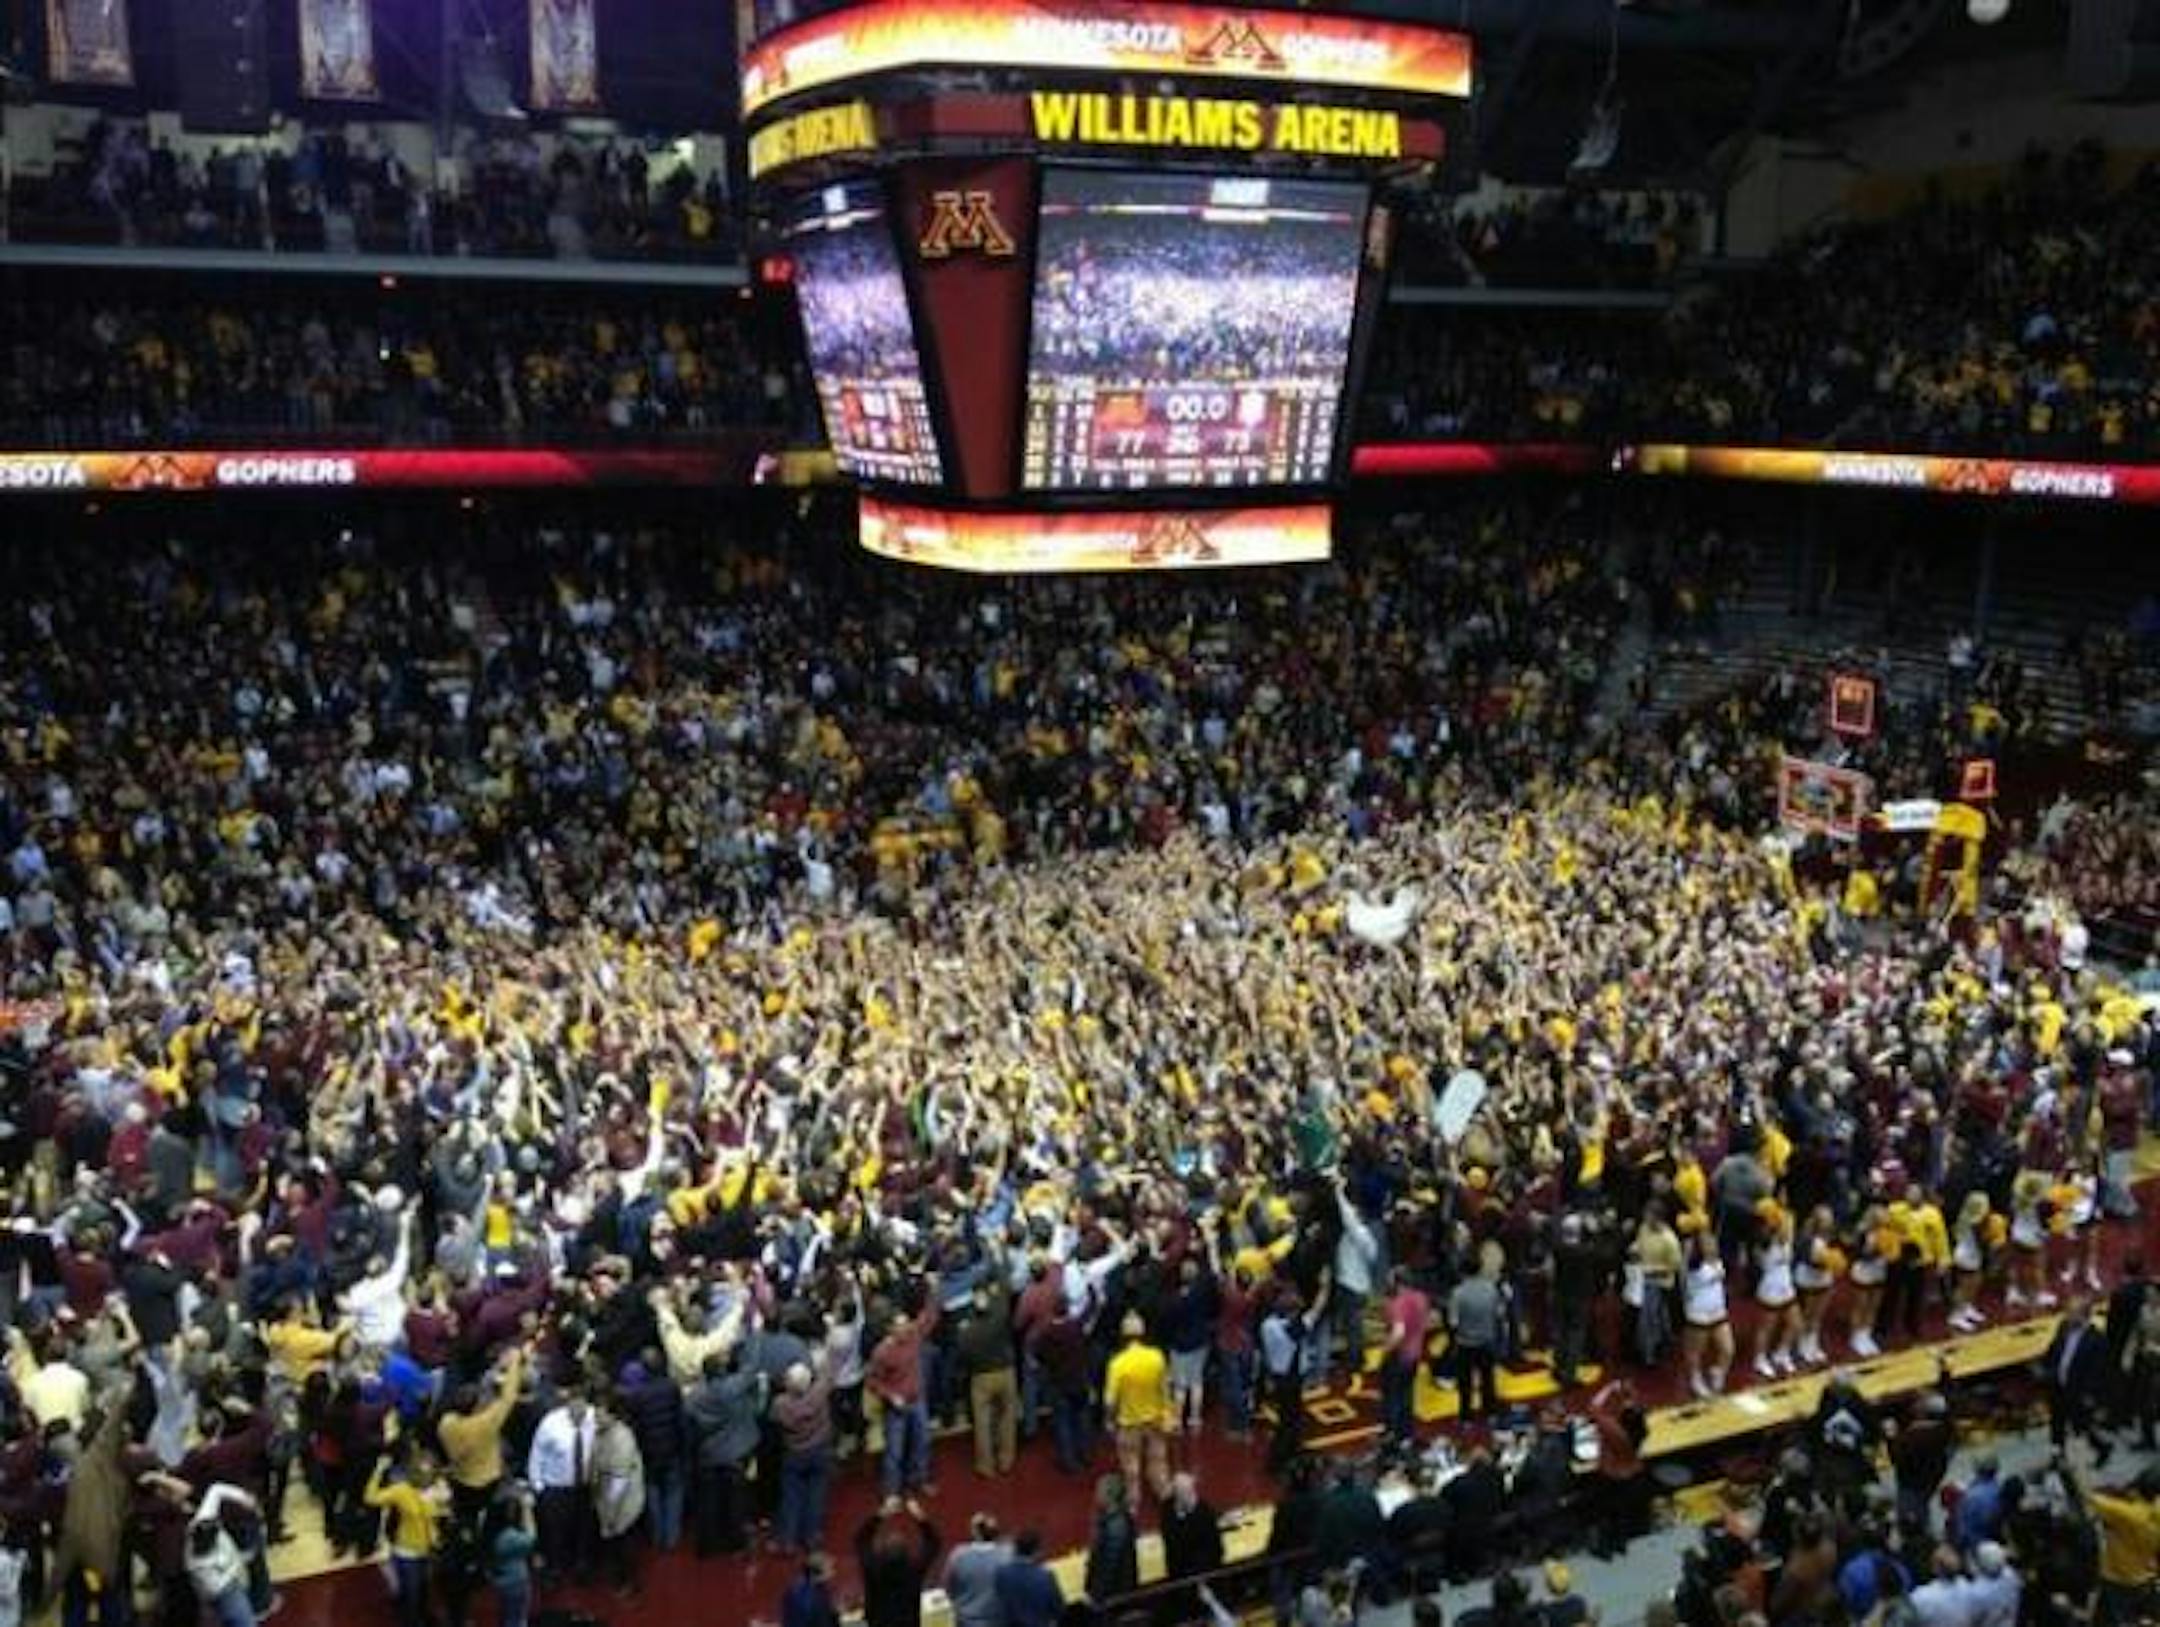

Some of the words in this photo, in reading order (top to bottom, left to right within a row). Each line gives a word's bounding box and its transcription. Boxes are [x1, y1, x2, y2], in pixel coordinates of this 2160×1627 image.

[1031, 91, 1262, 148] WILLIAMS
[1274, 103, 1401, 158] ARENA
[920, 191, 1015, 259] M
[1165, 394, 1228, 421] 00.0
[216, 458, 357, 487] GOPHERS
[1822, 460, 1926, 487] MINNESOTA
[2009, 467, 2115, 499] GOPHERS
